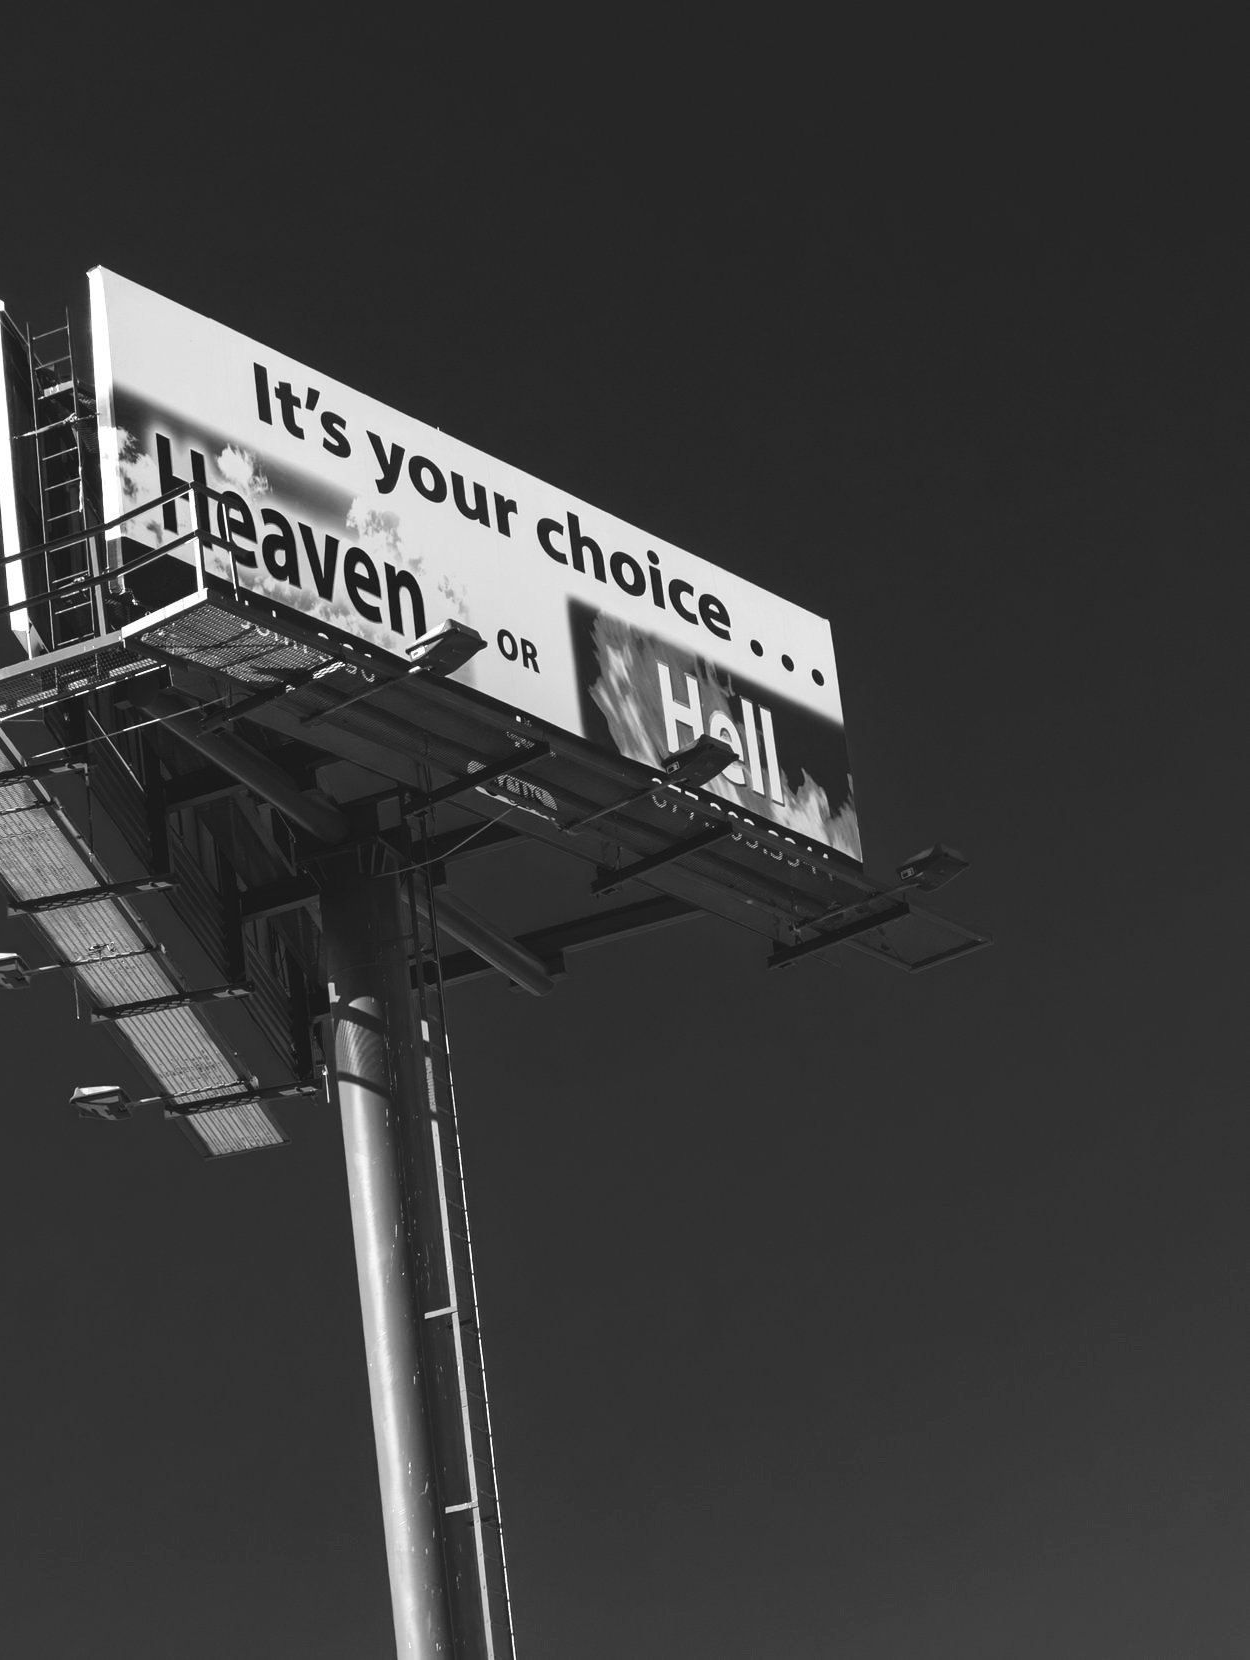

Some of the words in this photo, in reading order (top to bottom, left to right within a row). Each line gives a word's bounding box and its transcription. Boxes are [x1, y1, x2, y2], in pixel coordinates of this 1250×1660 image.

[155, 433, 427, 641] Heaven
[253, 362, 351, 458] It’s
[366, 430, 518, 538] your
[534, 511, 732, 641] choice
[497, 628, 541, 674] OR
